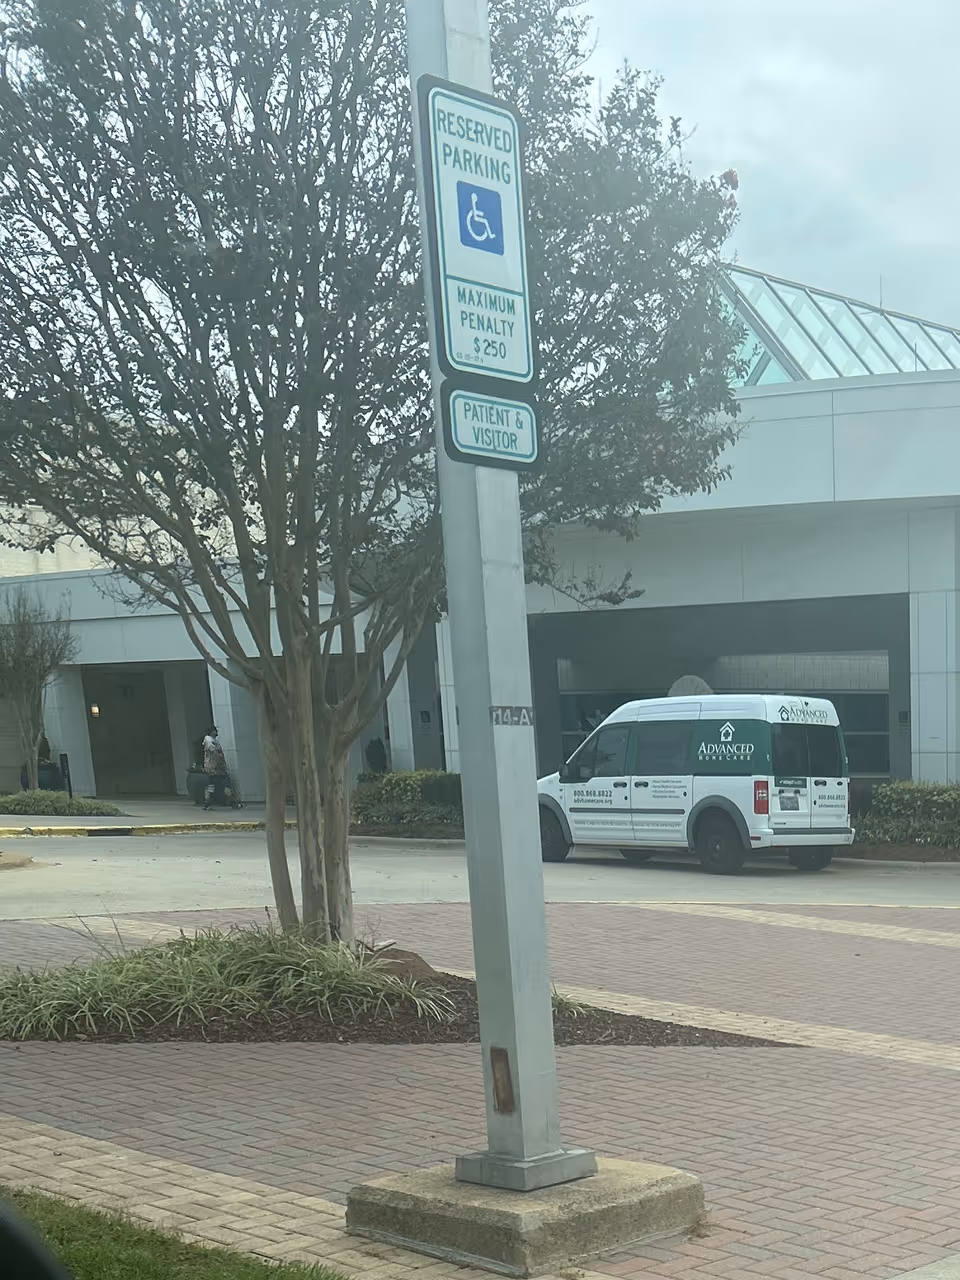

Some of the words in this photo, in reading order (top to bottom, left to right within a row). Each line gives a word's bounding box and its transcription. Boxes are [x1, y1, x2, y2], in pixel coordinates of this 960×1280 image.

[437, 108, 512, 153] RESERVED
[443, 142, 511, 184] PARKING
[457, 286, 515, 315] MAXIMUM
[461, 310, 514, 338] PENALTY
[473, 336, 507, 359] $250
[464, 401, 511, 427] PATIENT
[515, 411, 524, 430] &
[472, 426, 518, 451] VISITOR
[790, 707, 828, 719] ADVANCED
[698, 741, 755, 755] ADVANCED
